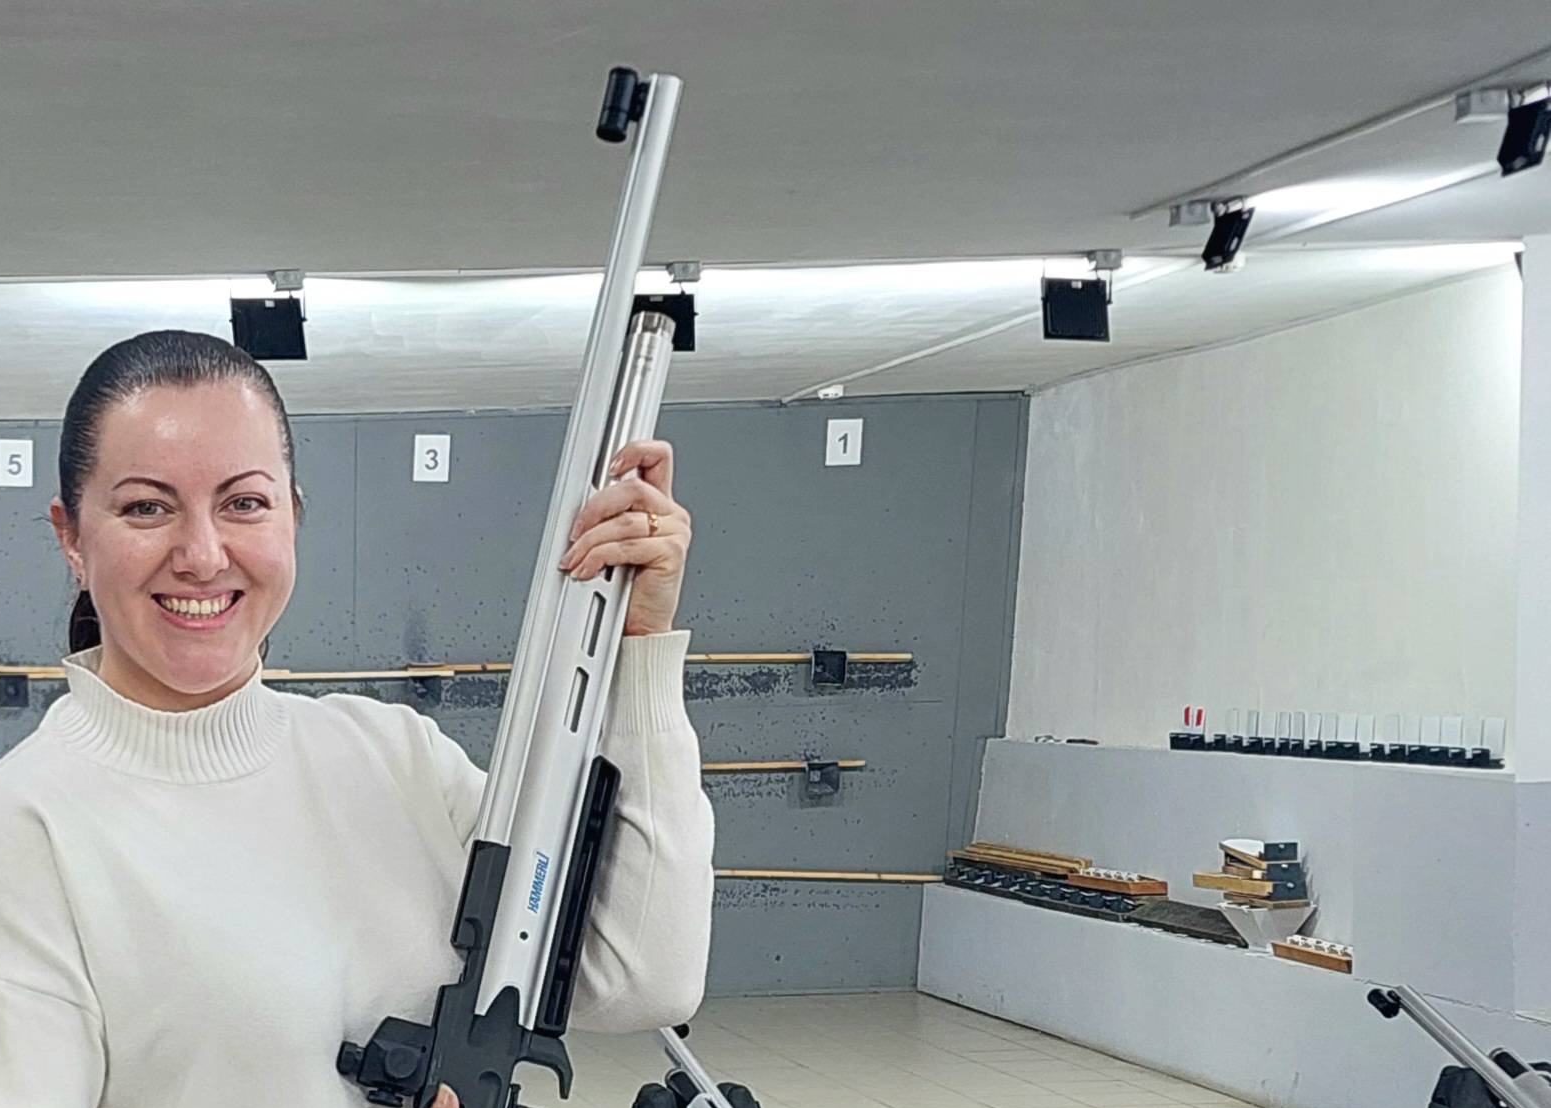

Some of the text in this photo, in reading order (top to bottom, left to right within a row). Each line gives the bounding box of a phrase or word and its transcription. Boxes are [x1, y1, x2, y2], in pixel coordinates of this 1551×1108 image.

[837, 432, 849, 455] 1
[6, 453, 23, 476] 5
[424, 448, 439, 471] 3
